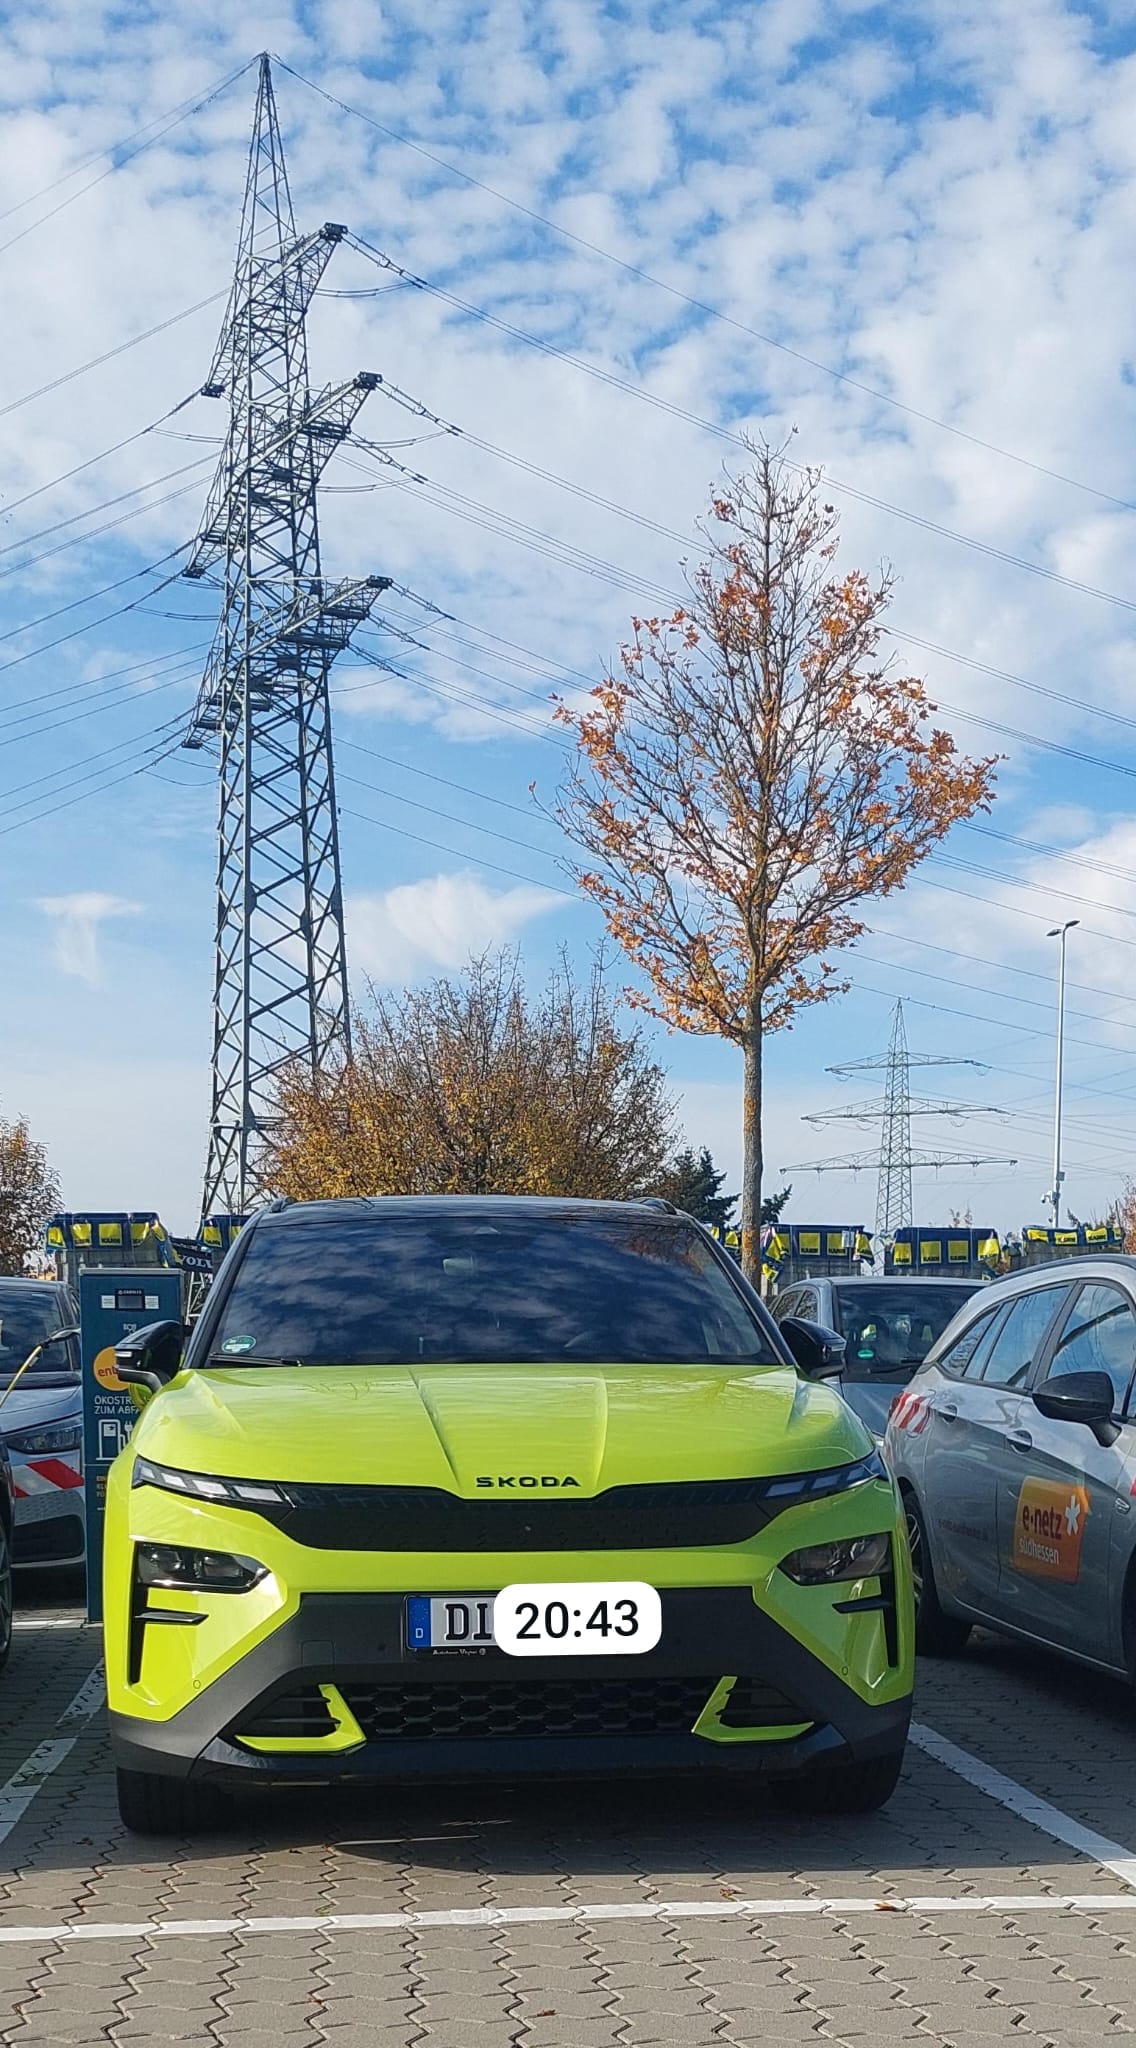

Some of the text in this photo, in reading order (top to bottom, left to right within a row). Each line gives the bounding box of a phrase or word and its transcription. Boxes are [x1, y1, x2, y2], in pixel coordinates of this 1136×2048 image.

[94, 1395, 134, 1405] ÖKOSTR
[94, 1406, 116, 1414] ZUM
[476, 1476, 581, 1488] SKODA
[415, 1628, 424, 1638] D
